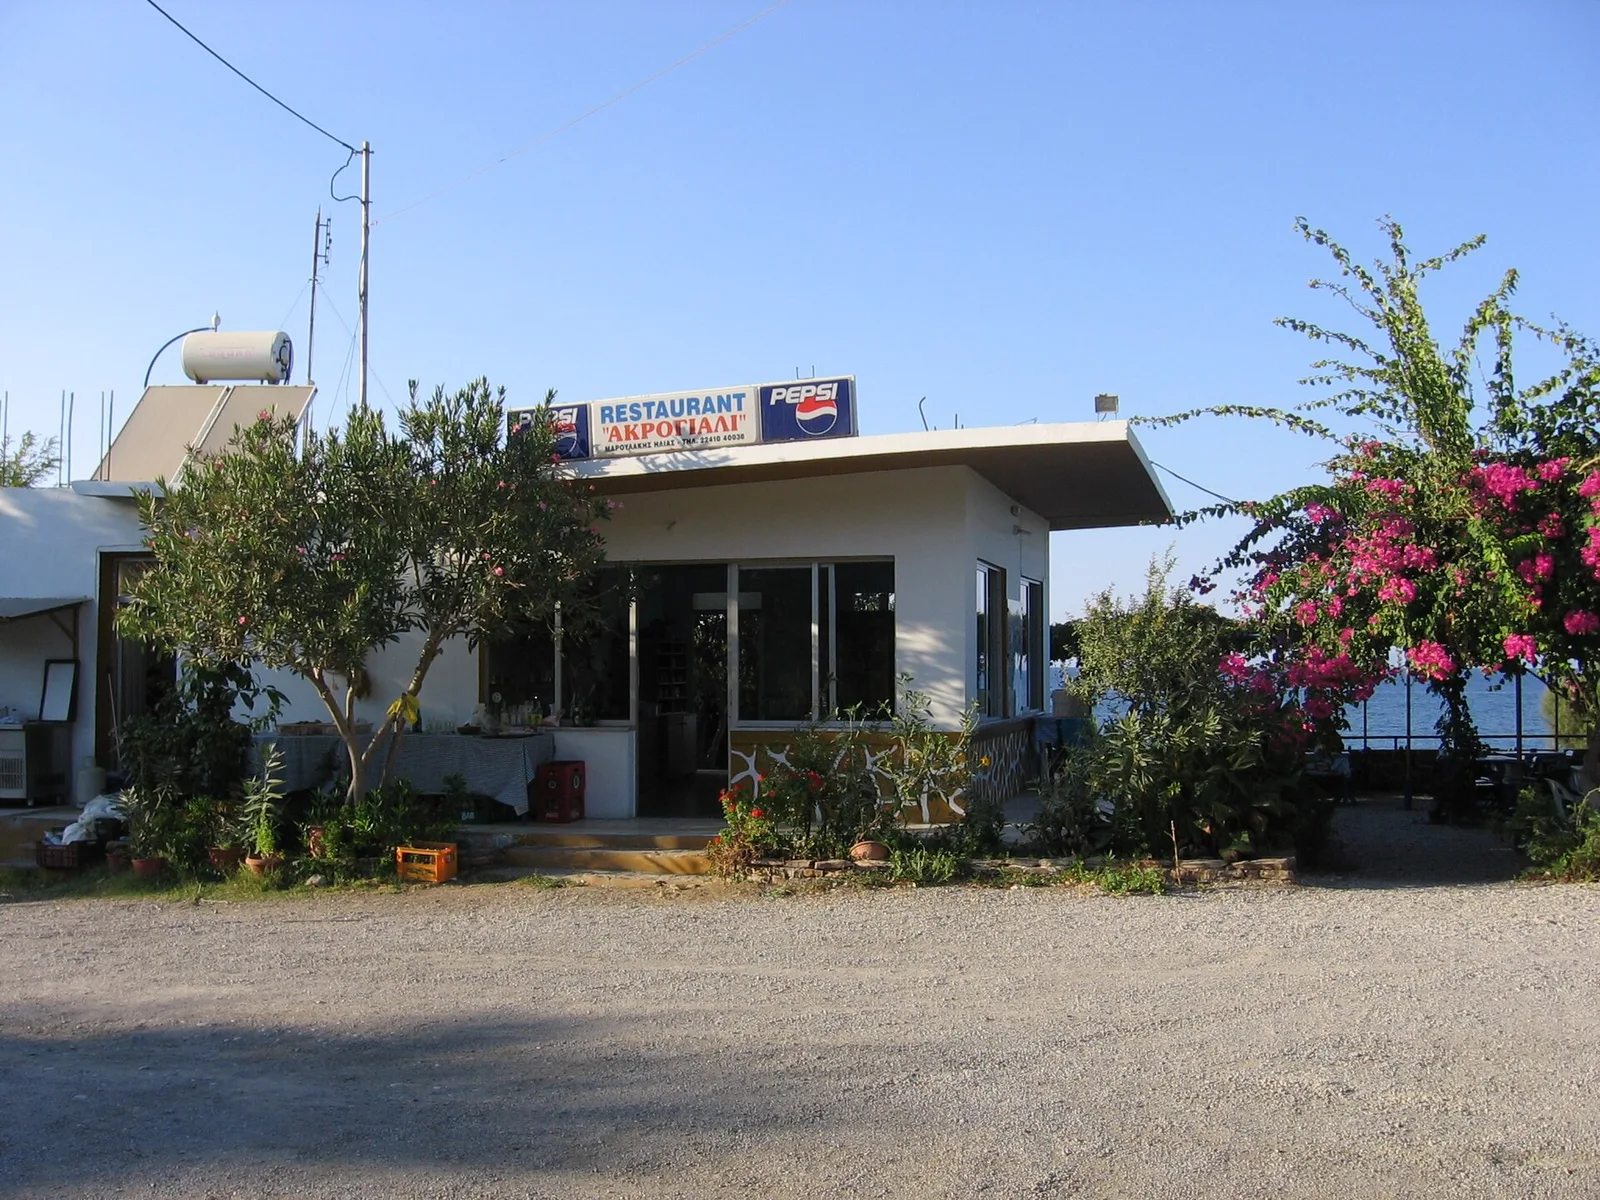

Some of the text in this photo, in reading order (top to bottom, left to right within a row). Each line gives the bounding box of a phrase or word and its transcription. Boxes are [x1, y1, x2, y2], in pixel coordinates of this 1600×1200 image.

[769, 382, 838, 406] PEPSI
[518, 407, 578, 427] PPSI
[600, 393, 746, 424] RESTAURANT
